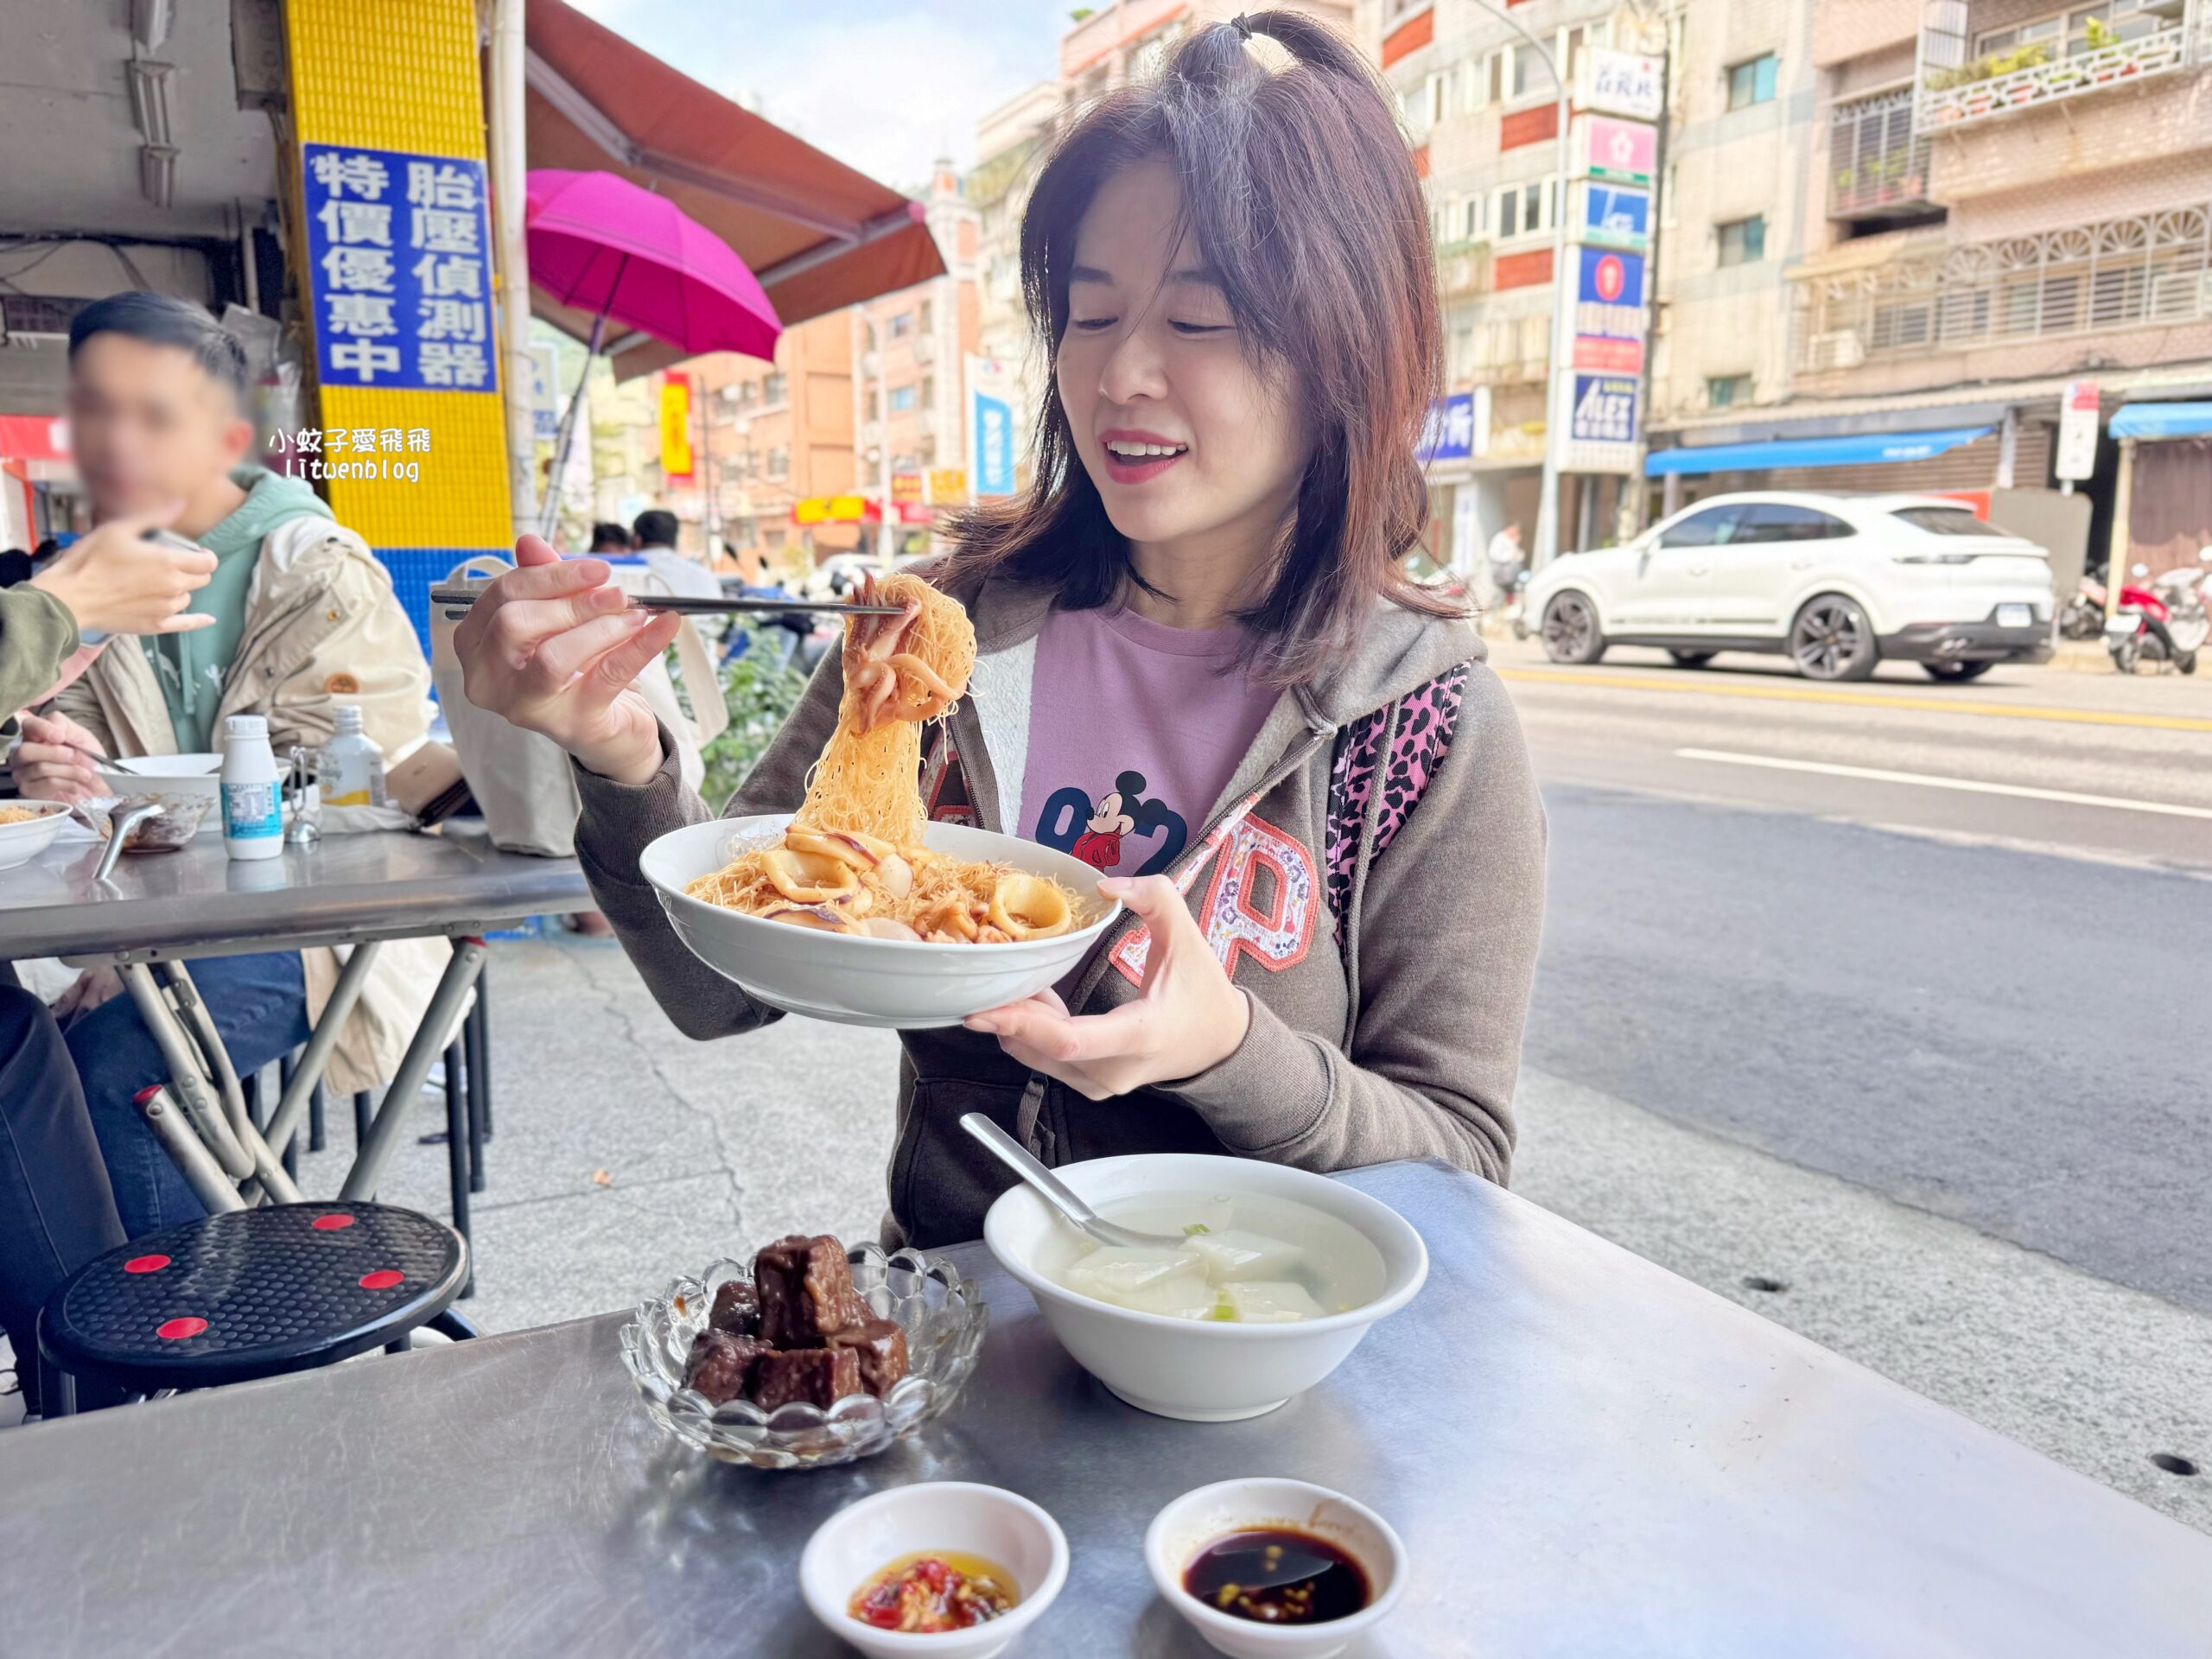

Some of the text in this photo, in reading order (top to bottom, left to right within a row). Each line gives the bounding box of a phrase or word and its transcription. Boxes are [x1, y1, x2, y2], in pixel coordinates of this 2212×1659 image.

[310, 152, 401, 382] 特價優惠中
[406, 162, 489, 387] 胎壓偵測器
